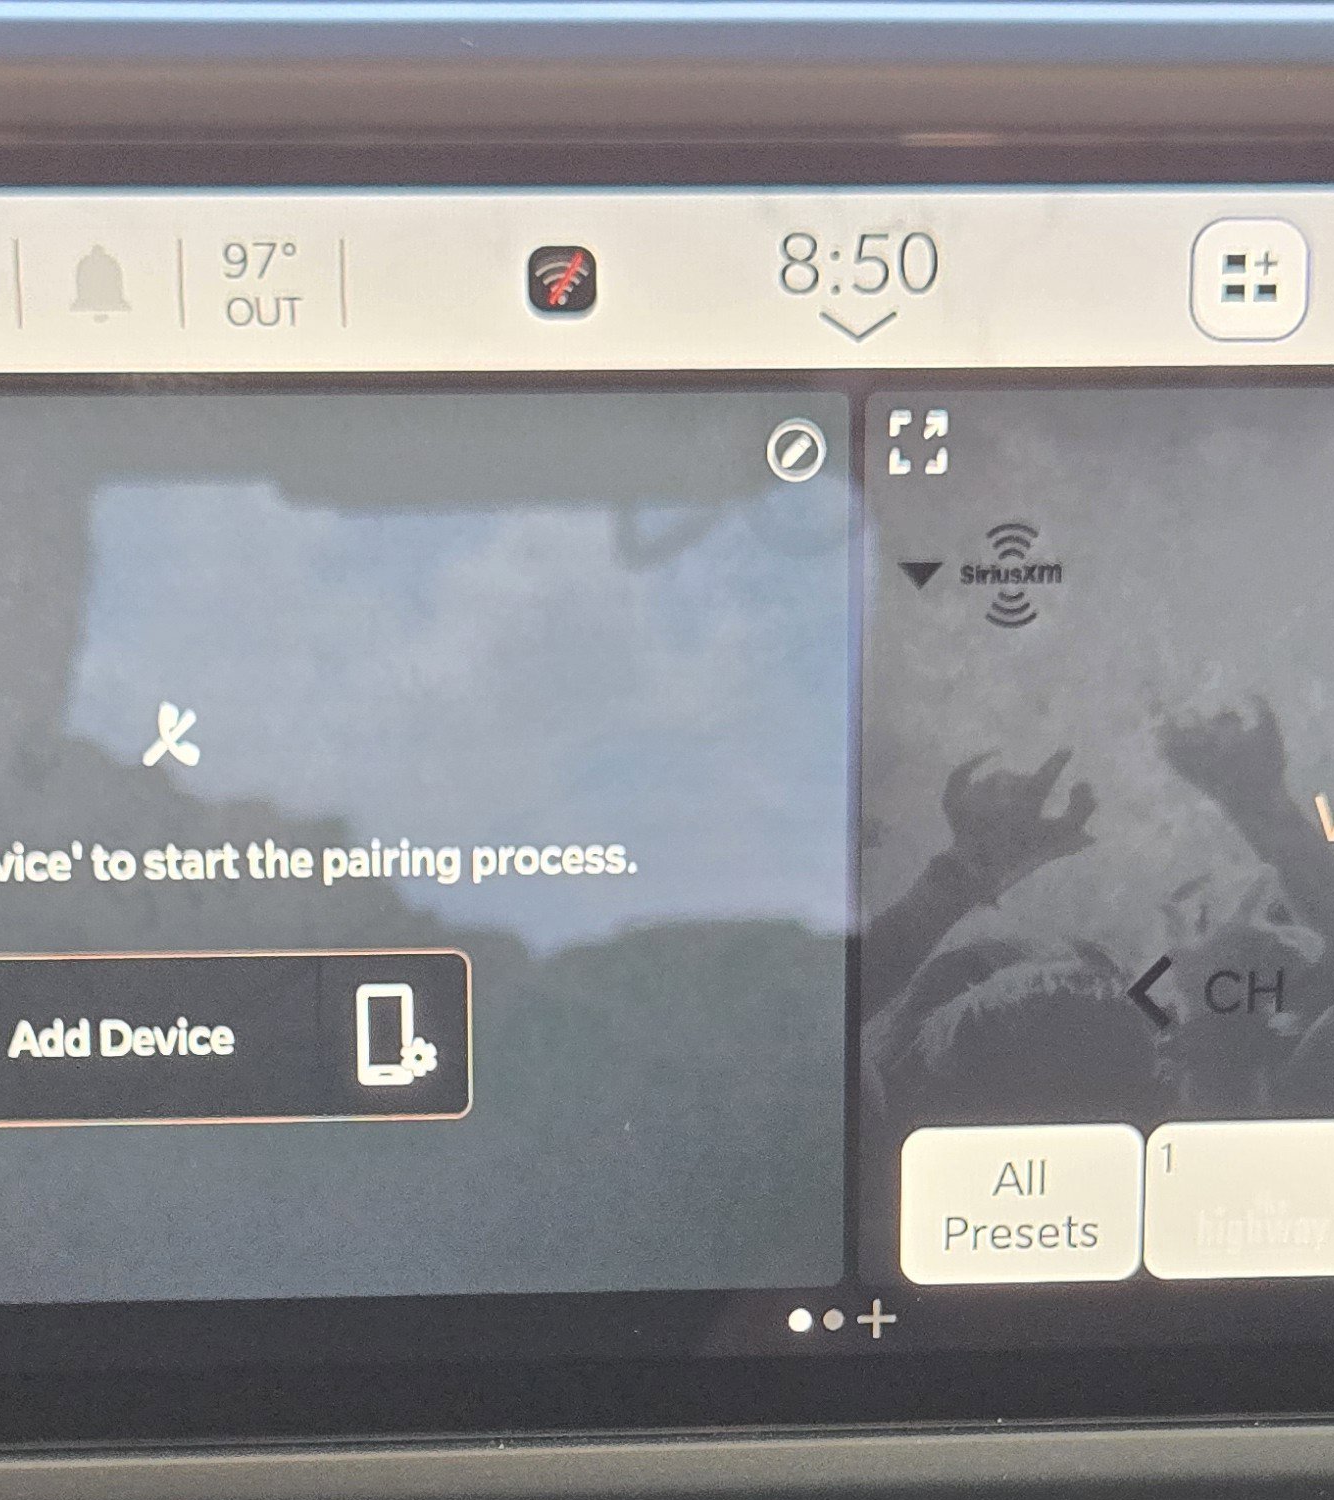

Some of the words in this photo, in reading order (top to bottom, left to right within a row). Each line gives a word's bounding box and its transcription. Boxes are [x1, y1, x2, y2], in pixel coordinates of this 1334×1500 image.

[778, 231, 941, 297] 8:50
[225, 296, 303, 329] OUT
[91, 847, 137, 883] to
[143, 844, 240, 882] start
[247, 841, 313, 880] the
[322, 838, 461, 885] pairing
[470, 844, 638, 882] process.
[1203, 968, 1286, 1015] CH
[6, 1019, 91, 1060] Add
[98, 1017, 236, 1060] Device
[991, 1158, 1047, 1197] All
[1160, 1141, 1174, 1174] 1
[943, 1213, 1099, 1251] Presets
